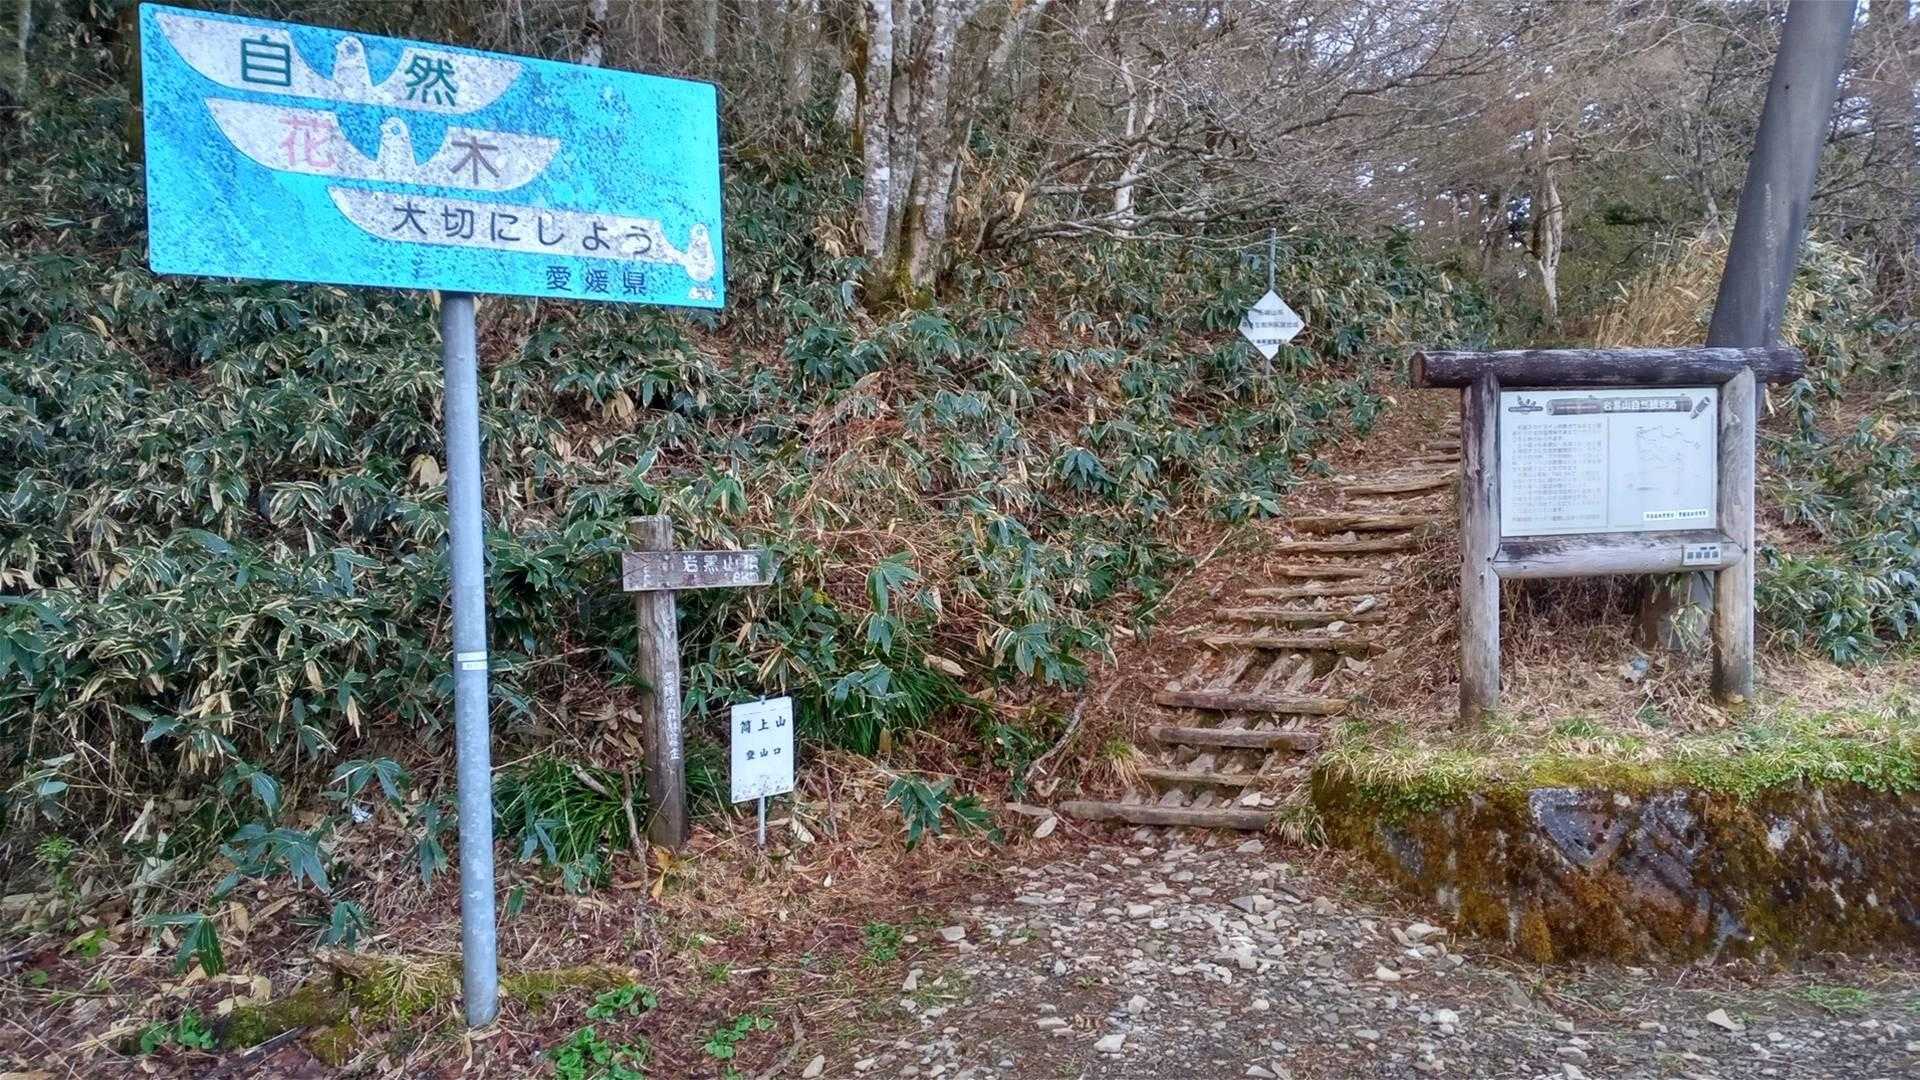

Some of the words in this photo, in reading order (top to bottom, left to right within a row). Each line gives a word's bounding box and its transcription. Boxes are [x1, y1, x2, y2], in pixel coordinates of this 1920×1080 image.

[392, 200, 653, 256] 大切にしよう
[545, 265, 648, 295] 愛媛県
[746, 747, 782, 761] 登山口
